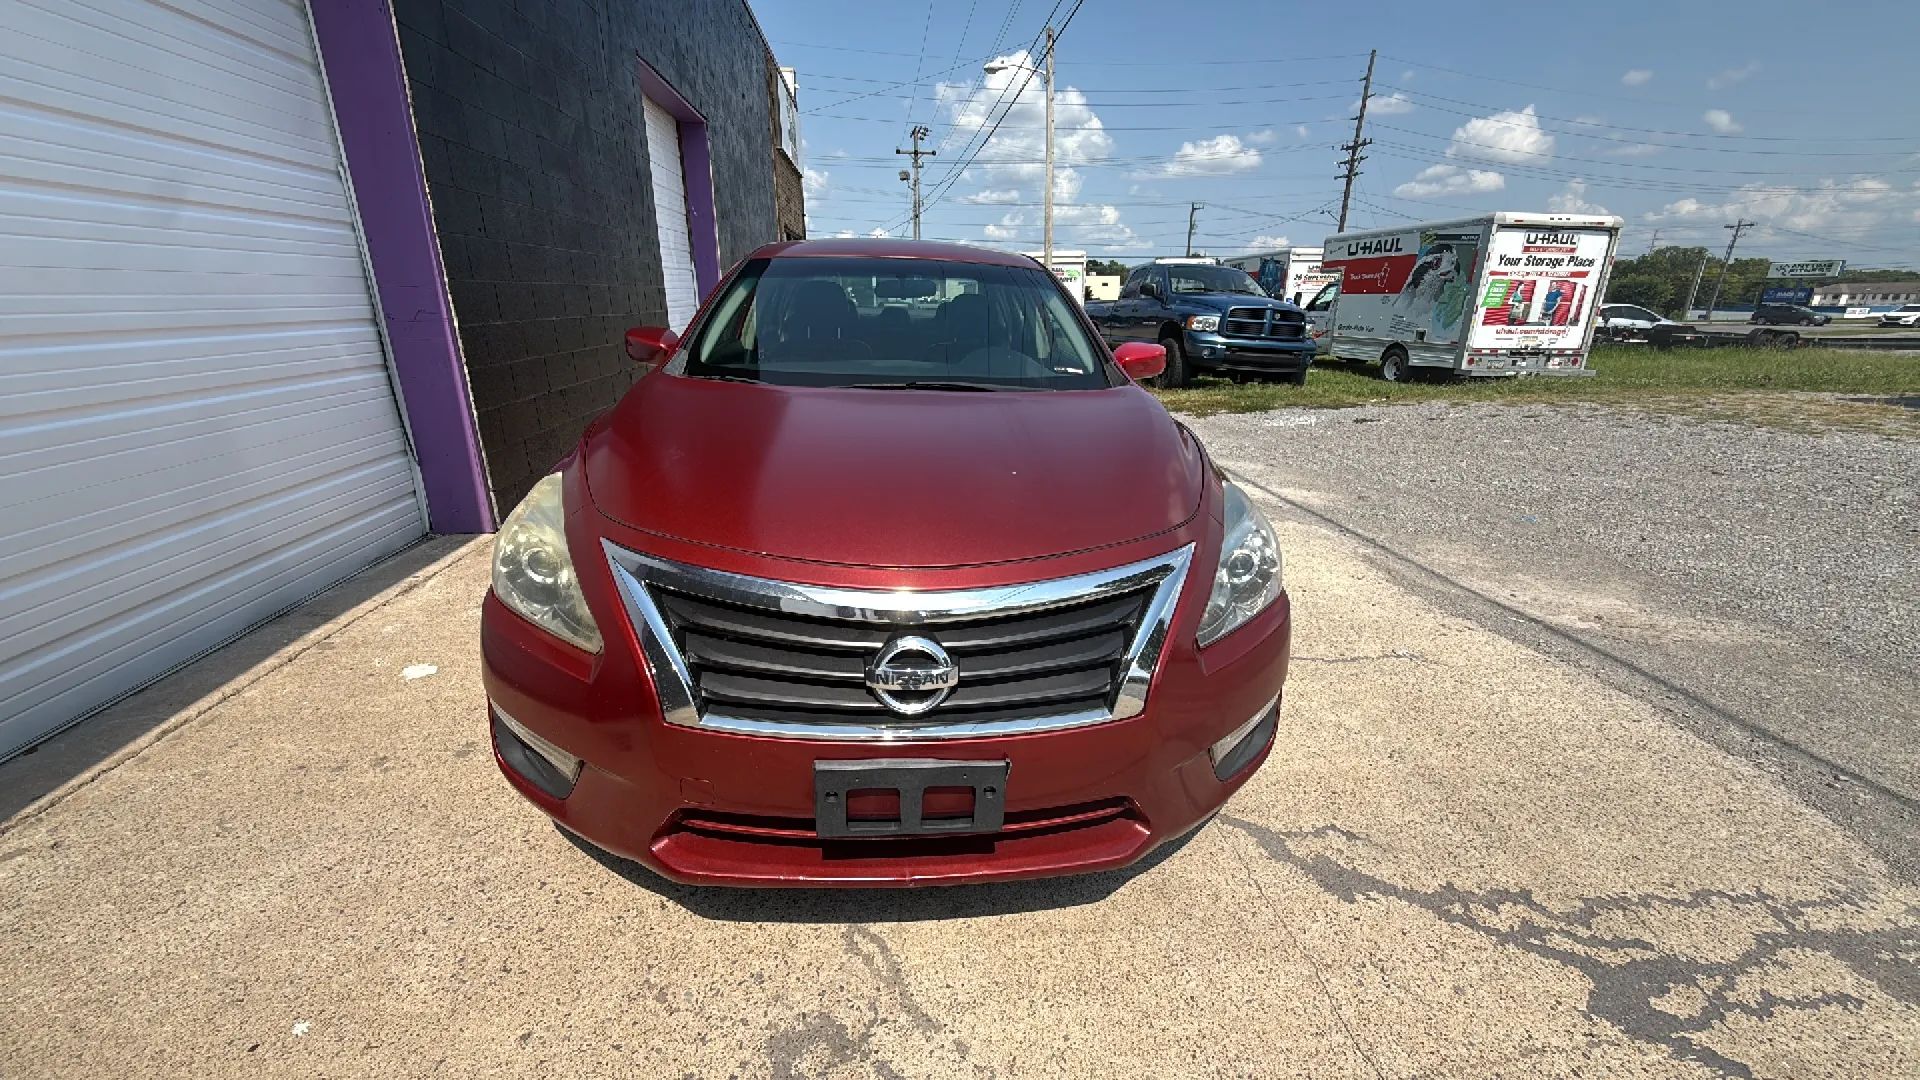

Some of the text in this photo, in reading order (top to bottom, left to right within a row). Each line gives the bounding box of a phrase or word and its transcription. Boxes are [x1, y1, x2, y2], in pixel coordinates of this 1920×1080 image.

[1526, 233, 1577, 245] U-HAUL
[1347, 238, 1403, 256] U-HAUL
[1498, 253, 1596, 269] Your Storage Place
[875, 672, 949, 686] NISSAN
